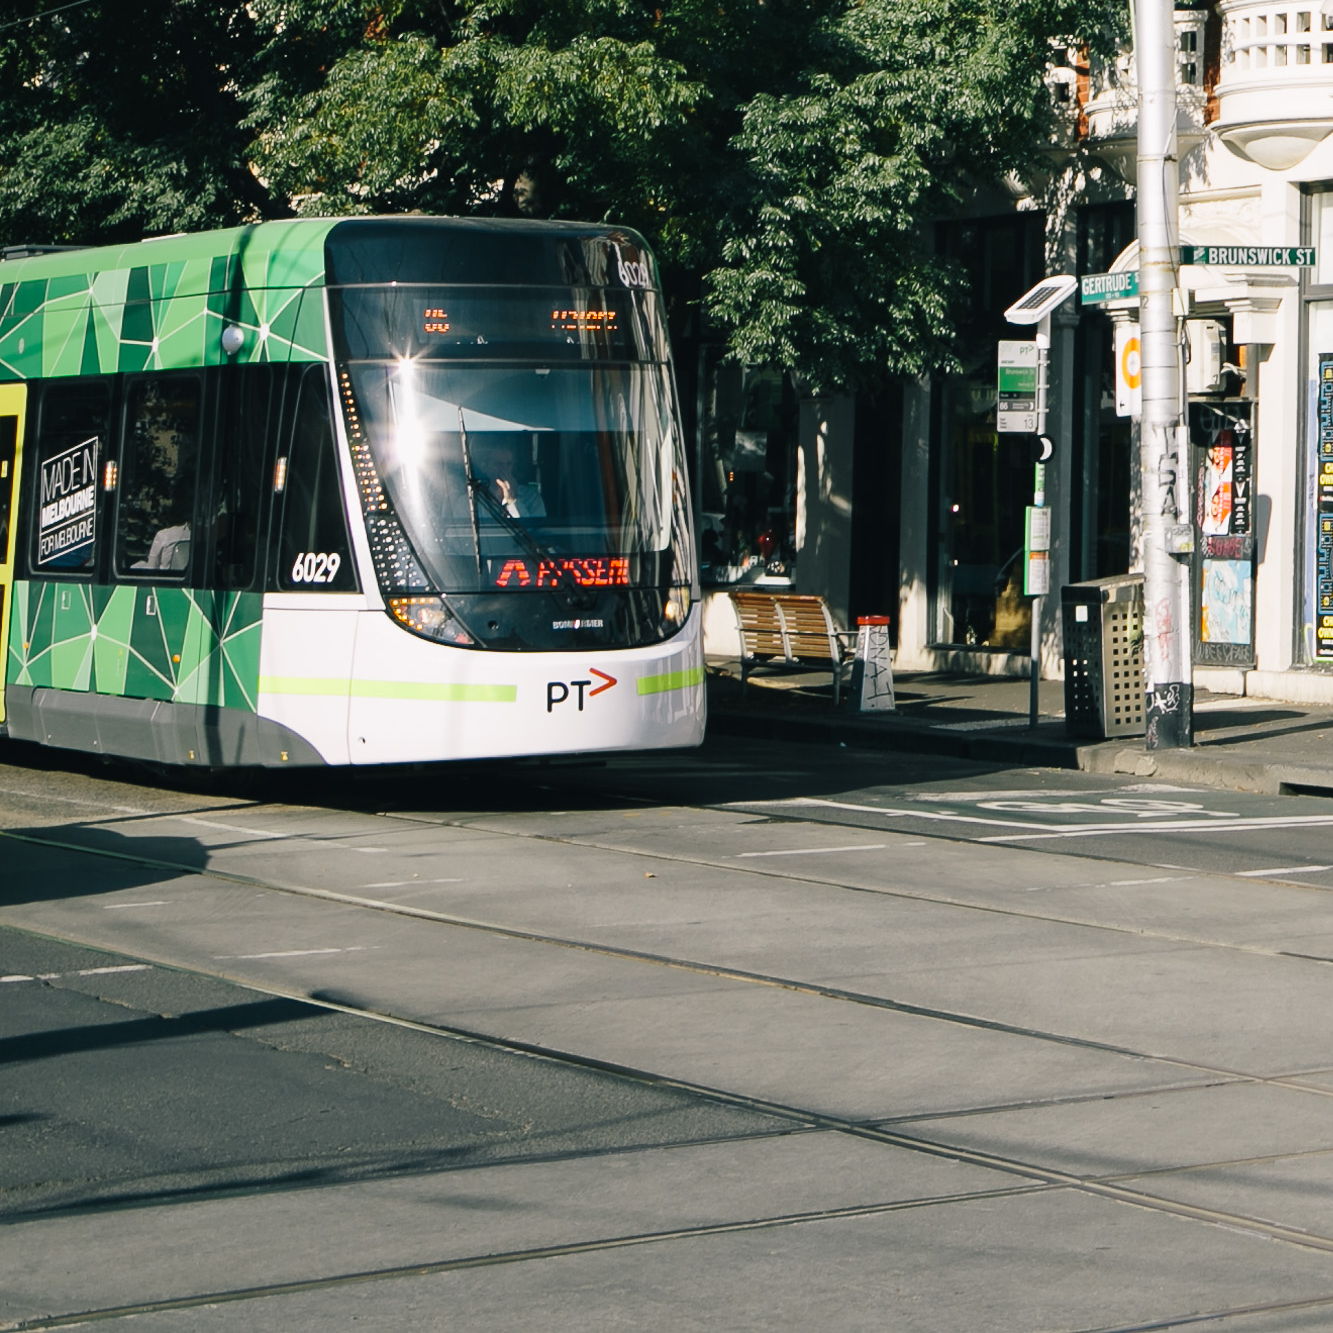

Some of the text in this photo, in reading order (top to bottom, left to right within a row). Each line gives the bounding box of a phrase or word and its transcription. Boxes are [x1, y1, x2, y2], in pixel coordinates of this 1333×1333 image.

[1208, 247, 1313, 265] BRUNSWICK ST
[1081, 273, 1132, 296] GERTRUDE
[42, 442, 96, 503] MADE IN
[42, 485, 95, 528] MELBOURNE
[41, 517, 93, 556] FOR MELBOURNE
[292, 552, 341, 583] 6029
[552, 619, 604, 629] BOMRDIER
[1318, 627, 1333, 639] OWN
